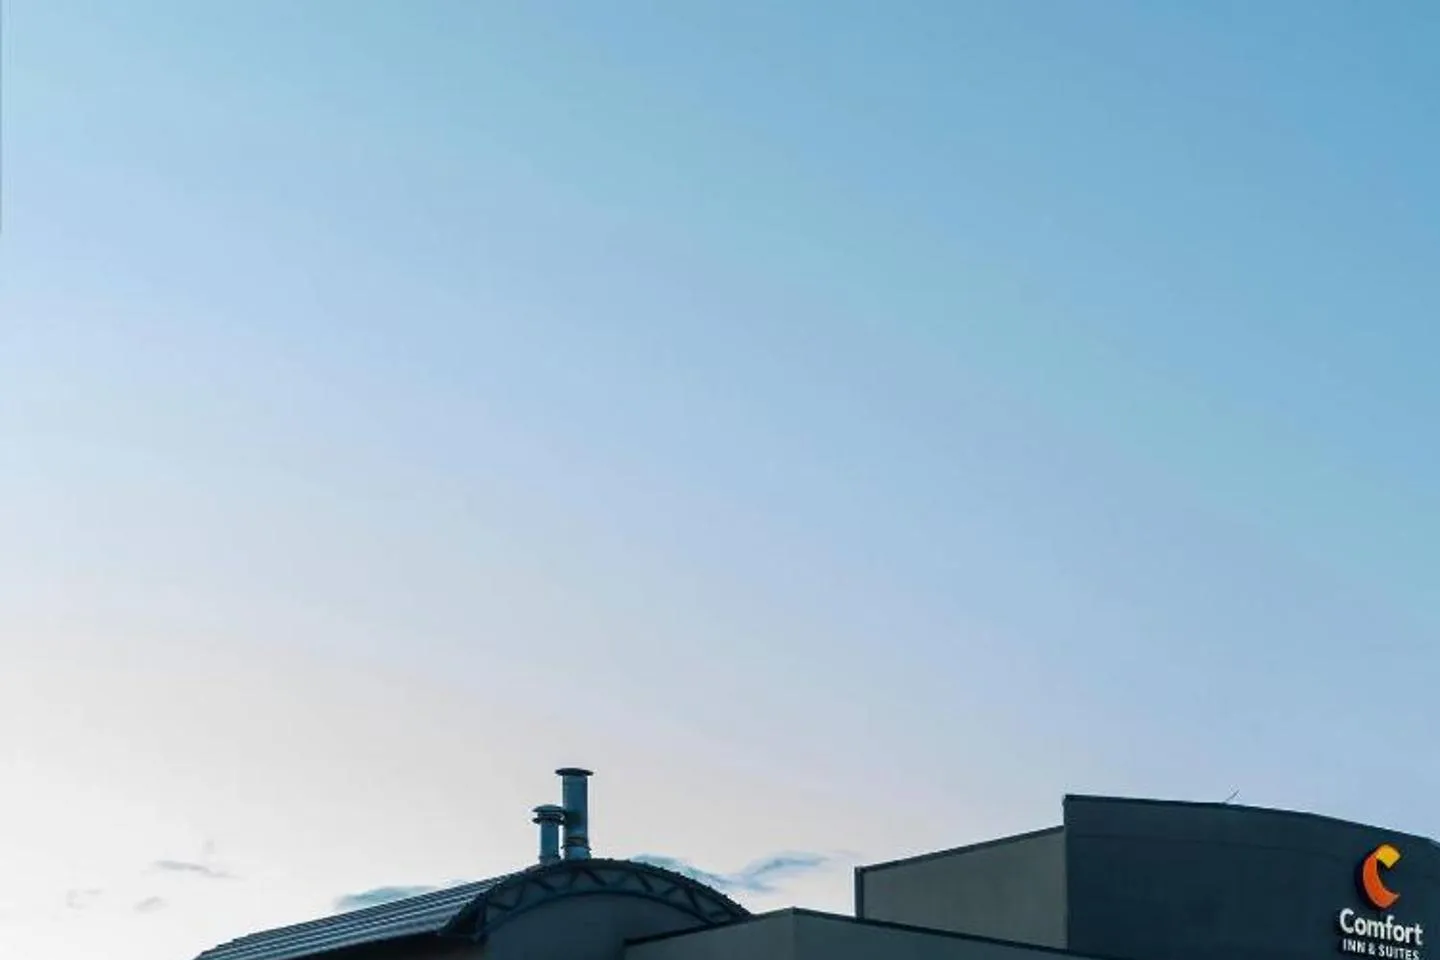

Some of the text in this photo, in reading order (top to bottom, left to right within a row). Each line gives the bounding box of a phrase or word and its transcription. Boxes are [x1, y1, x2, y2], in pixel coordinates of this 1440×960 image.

[1340, 907, 1423, 946] Comfort
[1343, 938, 1366, 954] INN
[1368, 941, 1376, 956] &
